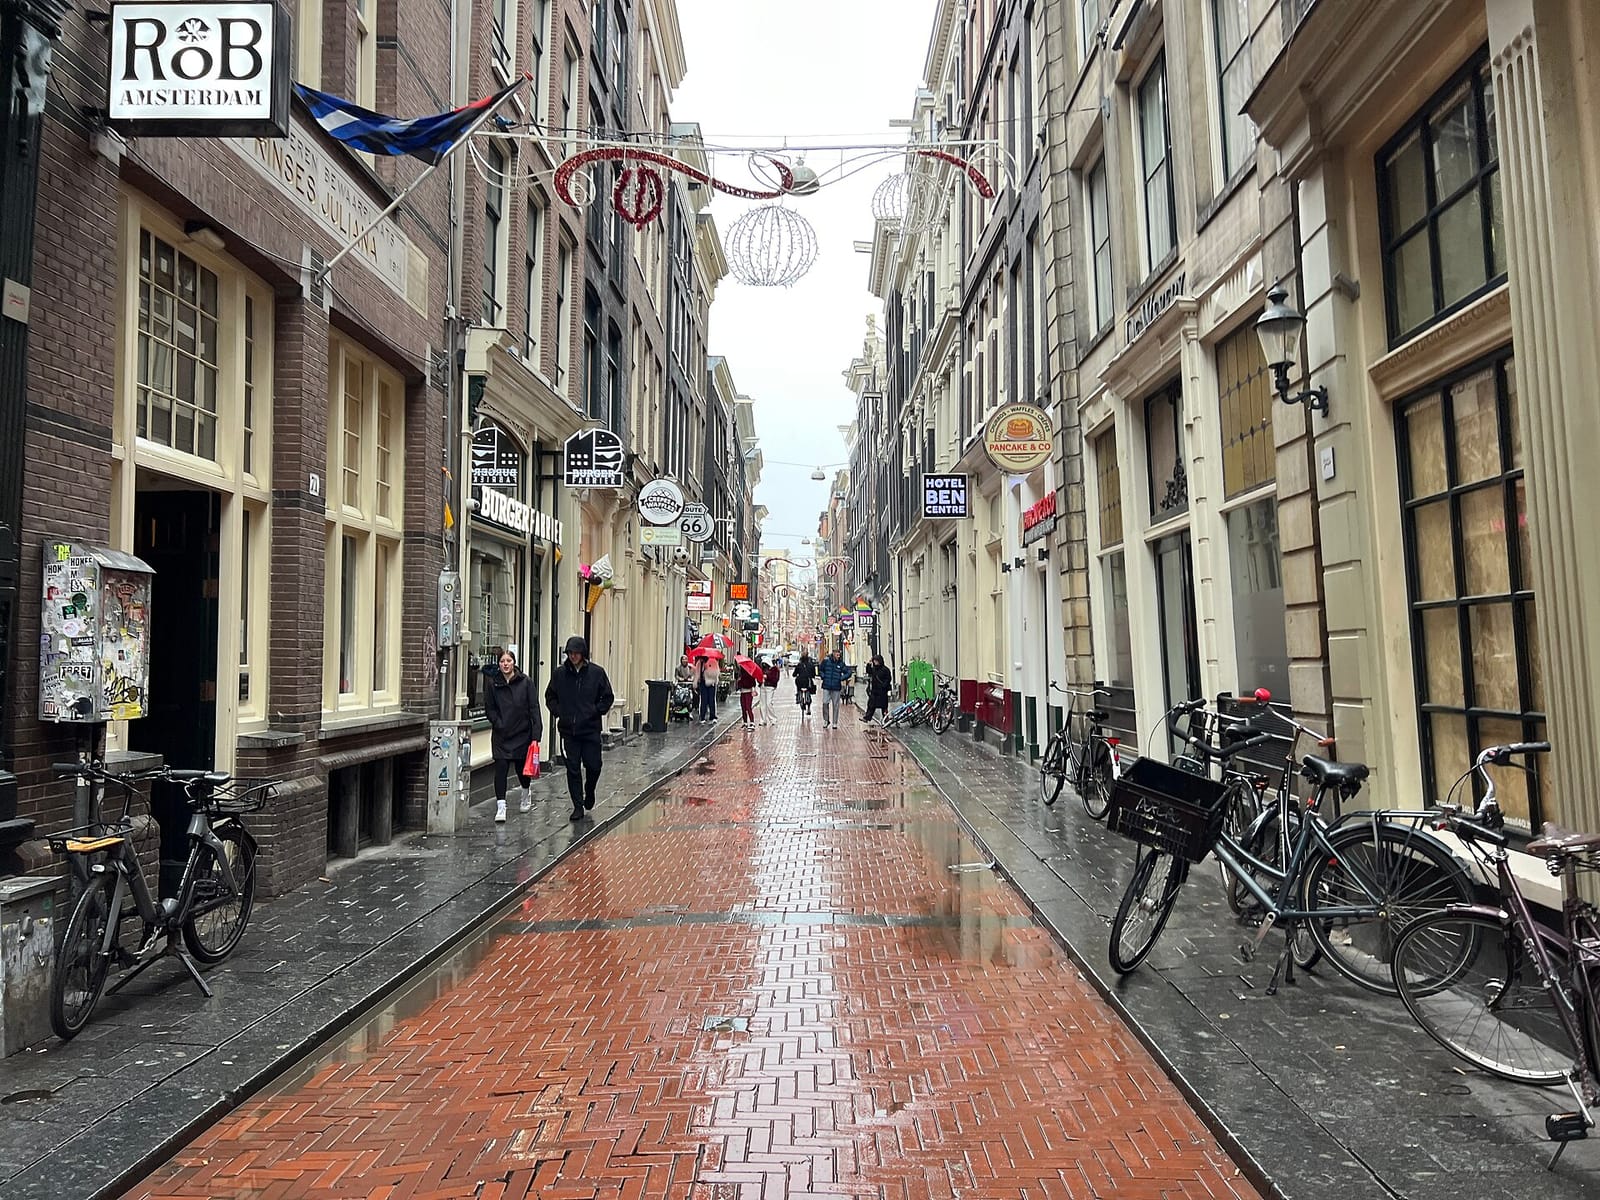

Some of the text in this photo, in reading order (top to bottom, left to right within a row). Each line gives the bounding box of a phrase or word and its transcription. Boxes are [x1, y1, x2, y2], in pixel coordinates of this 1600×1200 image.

[120, 89, 262, 106] AMSTERDAM
[253, 137, 317, 206] RINSES
[1010, 406, 1035, 415] WAFFLES
[989, 443, 1051, 452] PANCAKE & CO
[572, 468, 615, 478] BURGER
[572, 477, 616, 485] FABRIEK
[925, 478, 965, 489] HOTEL
[925, 489, 965, 505] BEN
[925, 505, 966, 514] CENTRE
[681, 519, 702, 532] 66
